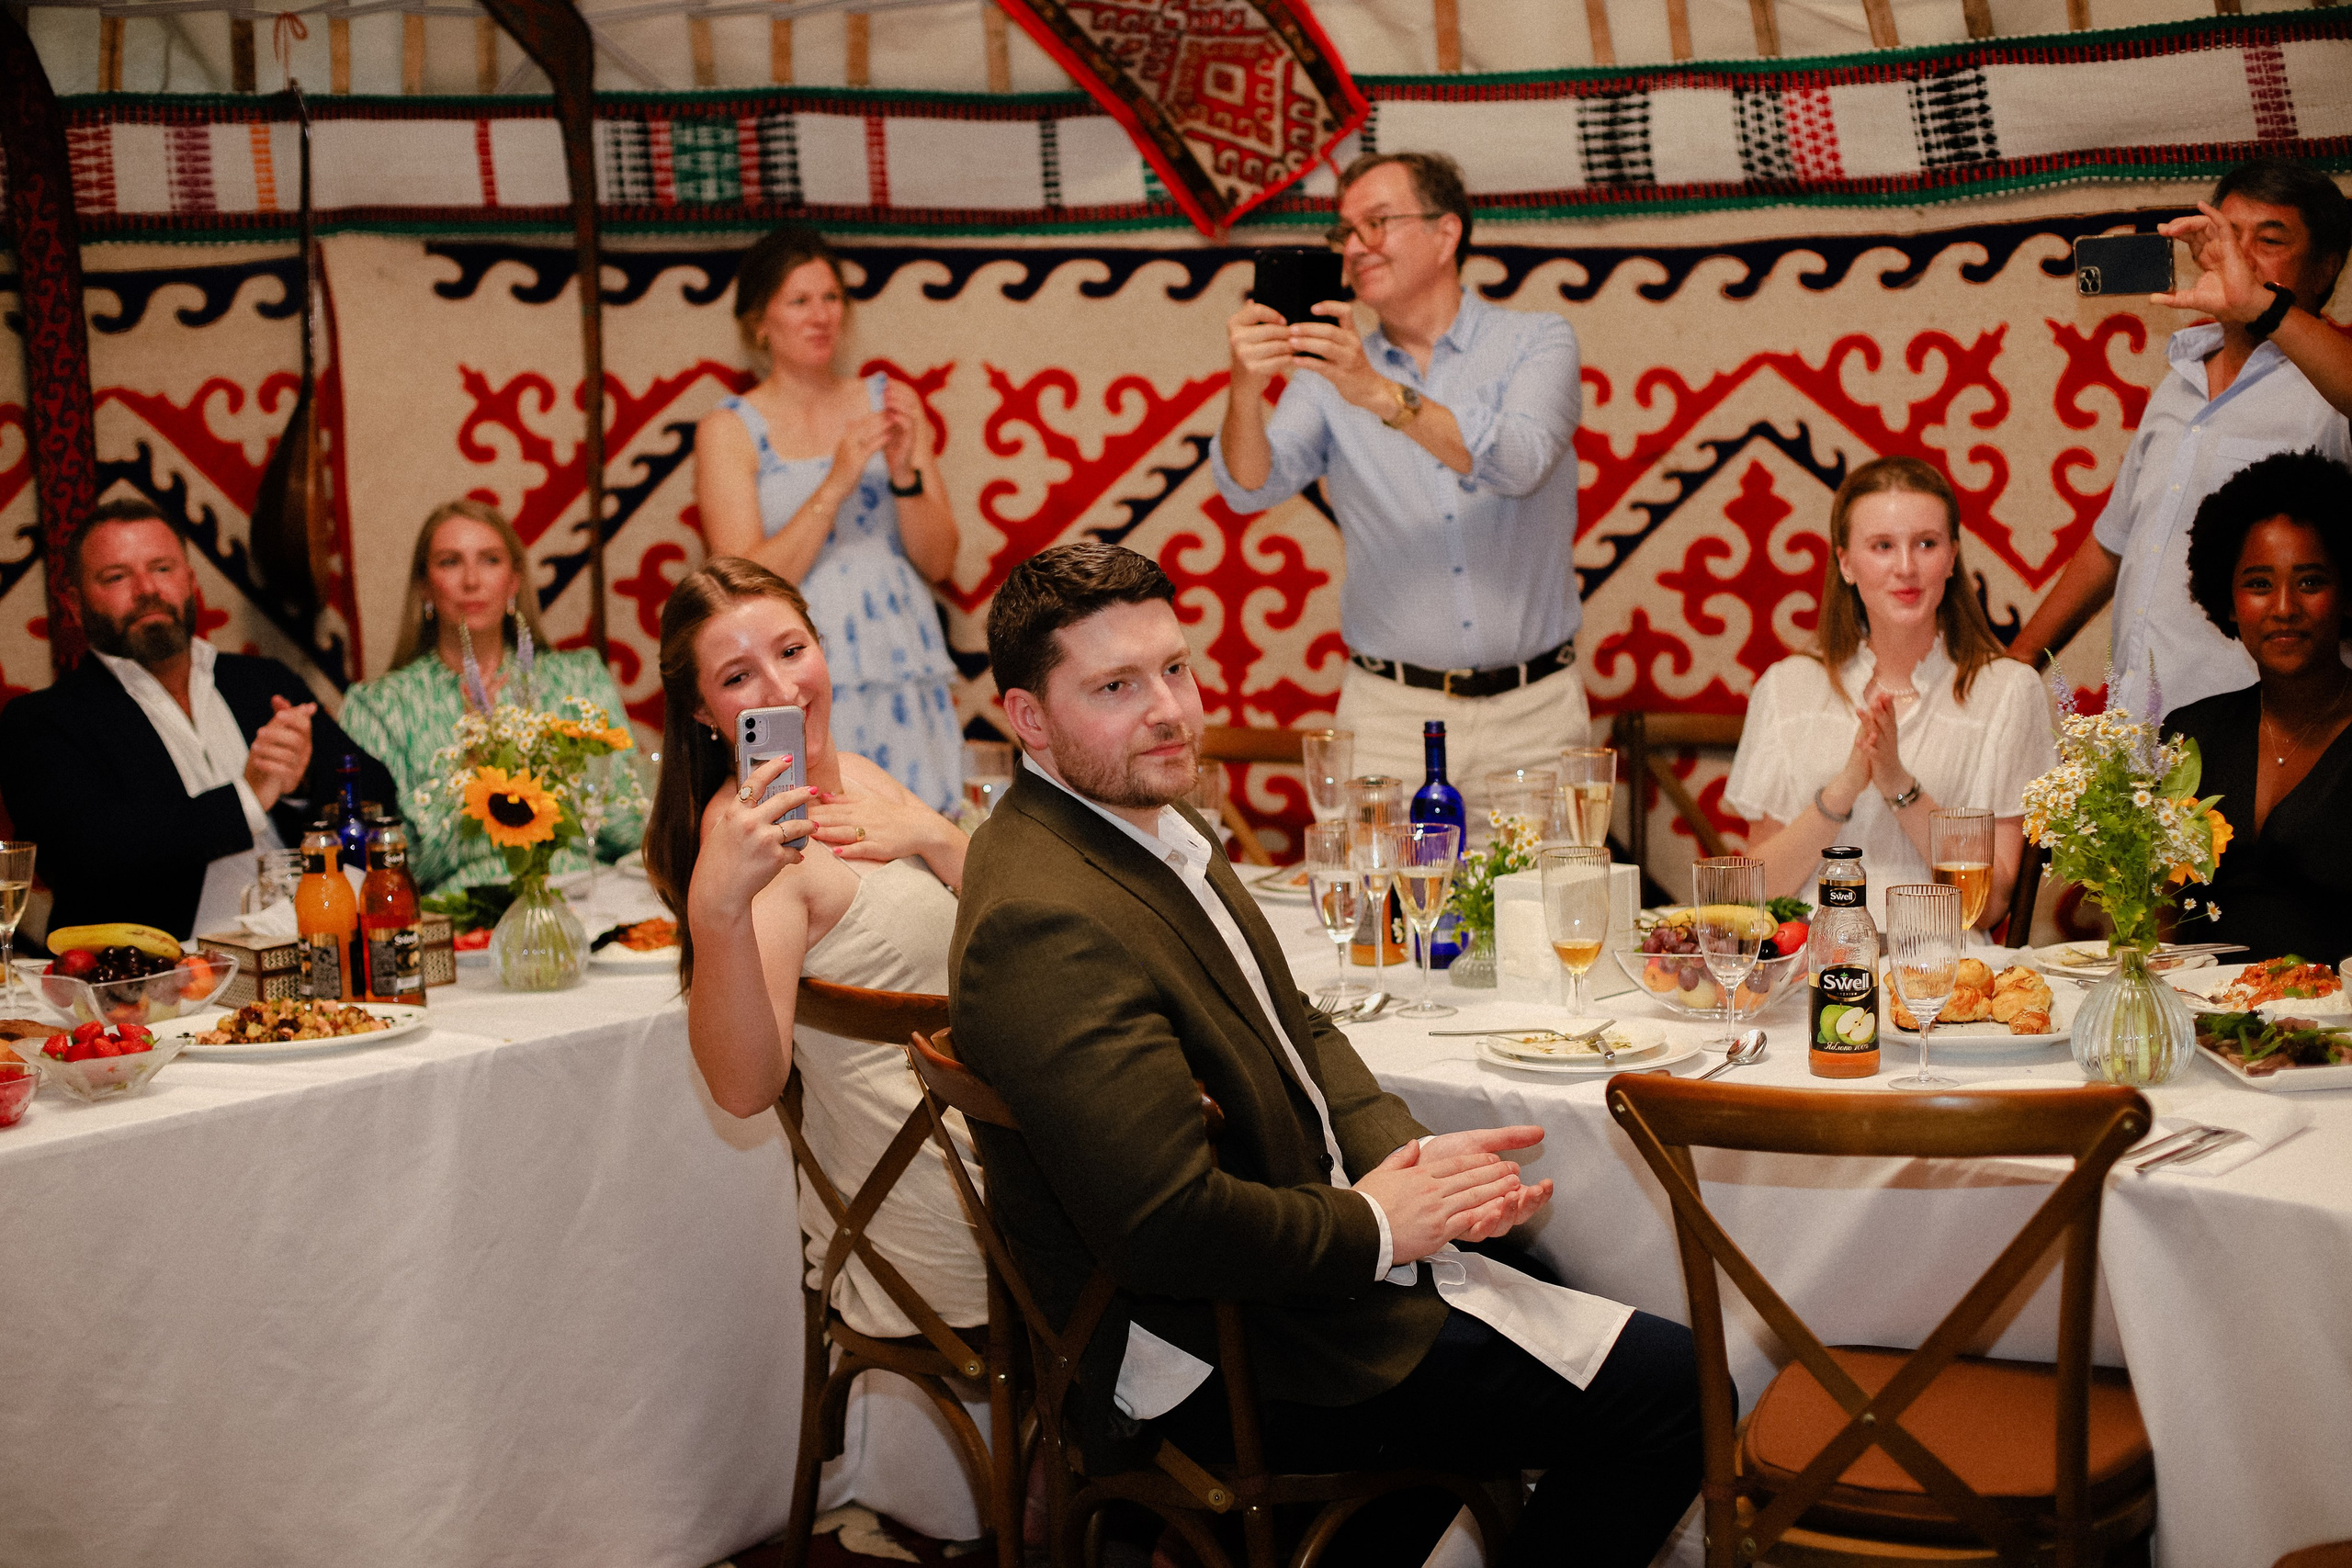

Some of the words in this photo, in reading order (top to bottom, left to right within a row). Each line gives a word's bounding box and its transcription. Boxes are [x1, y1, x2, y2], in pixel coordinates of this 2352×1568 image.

[1830, 891, 1853, 901] Swell
[1824, 972, 1870, 990] Swell
[1824, 1042, 1852, 1051] Яблоко
